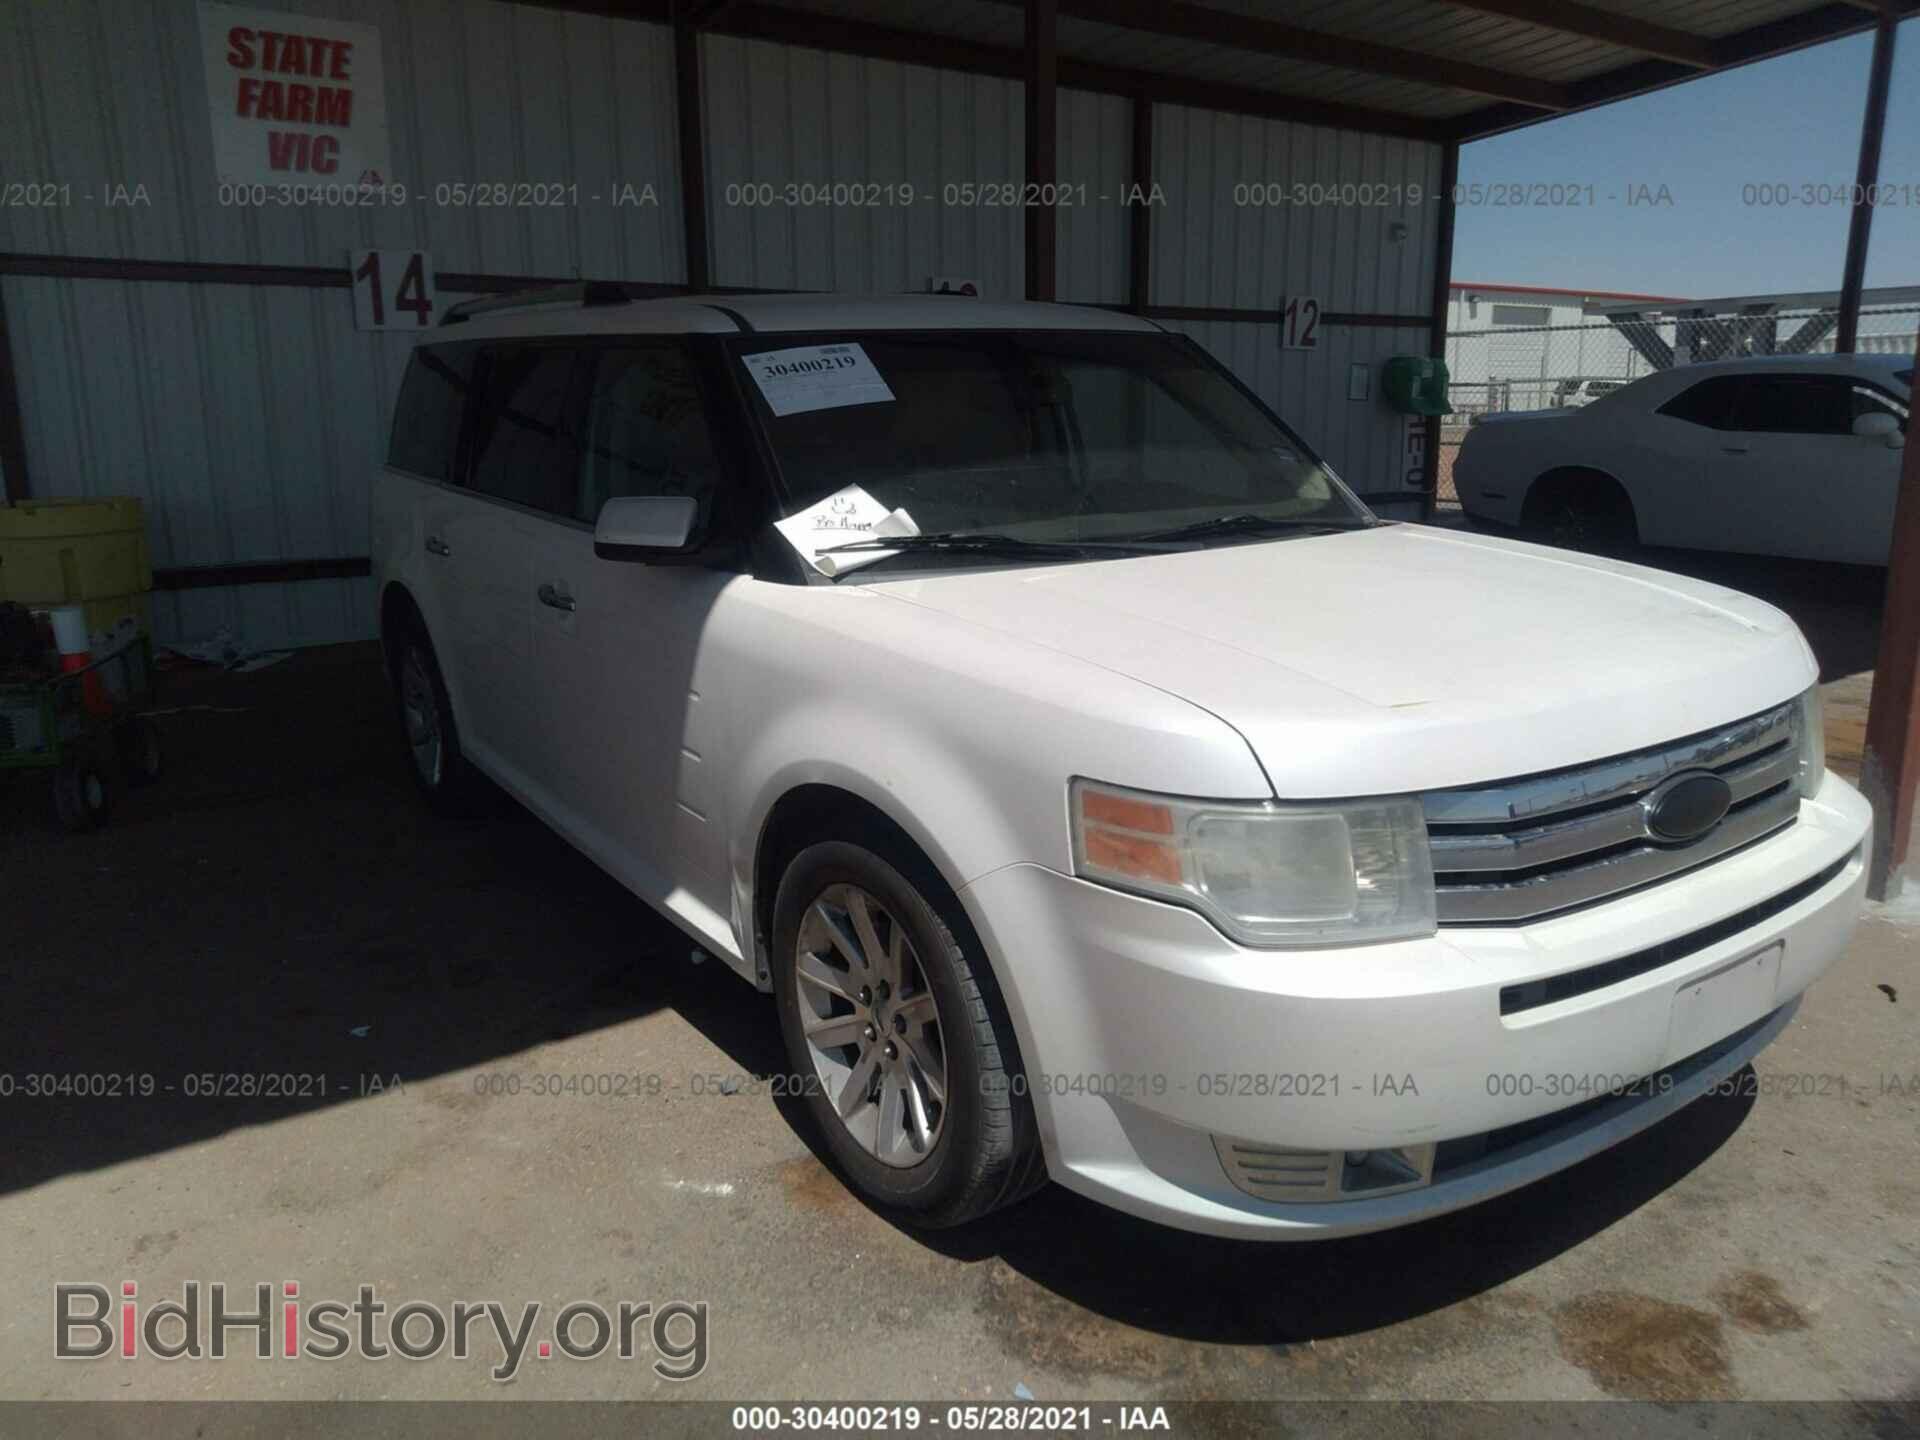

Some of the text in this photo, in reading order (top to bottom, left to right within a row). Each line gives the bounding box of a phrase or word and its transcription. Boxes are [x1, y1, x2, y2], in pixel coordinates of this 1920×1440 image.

[227, 26, 353, 80] STATE
[237, 76, 352, 128] FARM
[267, 131, 340, 174] VIC
[357, 252, 432, 326] 14
[1287, 298, 1318, 347] 12
[762, 356, 857, 379] 30400219
